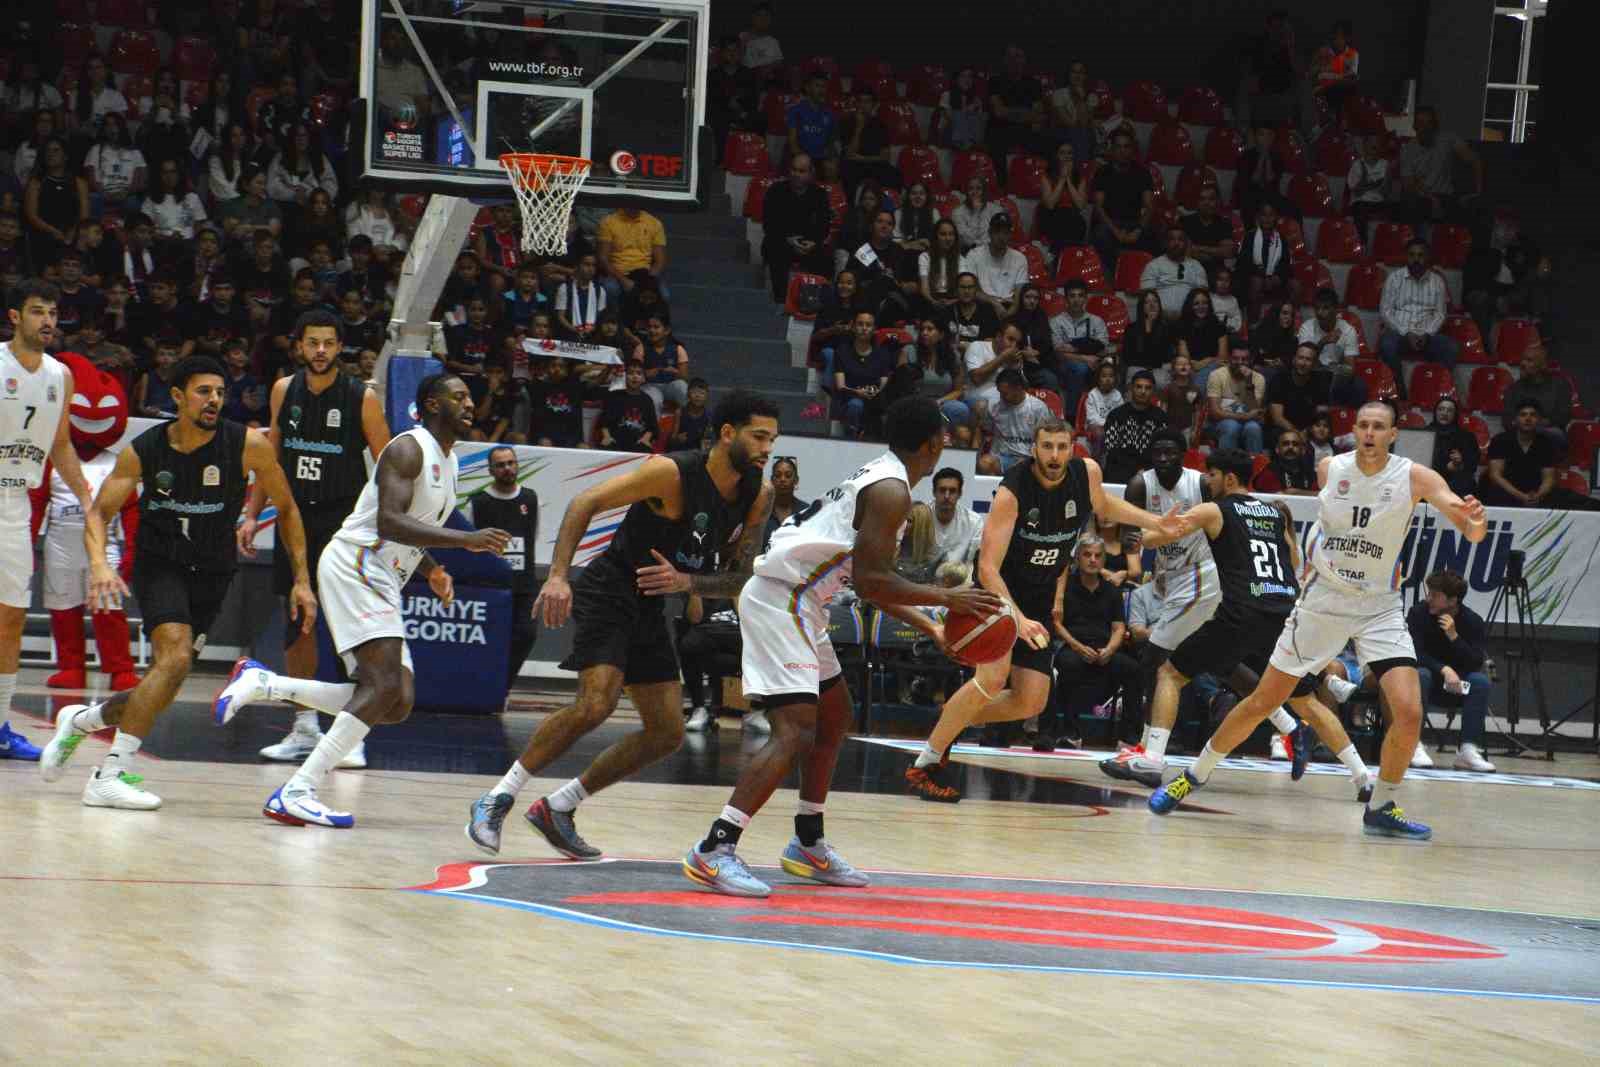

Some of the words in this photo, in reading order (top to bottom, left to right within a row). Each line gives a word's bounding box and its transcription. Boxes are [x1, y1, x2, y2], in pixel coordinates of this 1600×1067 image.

[488, 61, 584, 78] www.tbf.org.tr
[639, 153, 683, 177] TBF
[23, 405, 36, 430] 7
[296, 455, 323, 481] 65
[0, 477, 26, 488] STAR
[1352, 505, 1372, 529] 18
[1030, 548, 1060, 566] 22
[1249, 539, 1284, 582] 21
[1401, 515, 1515, 594] ÜNÜ
[1337, 568, 1365, 580] STAR
[400, 596, 488, 621] ÜRKİYE
[403, 619, 488, 645] GORTA
